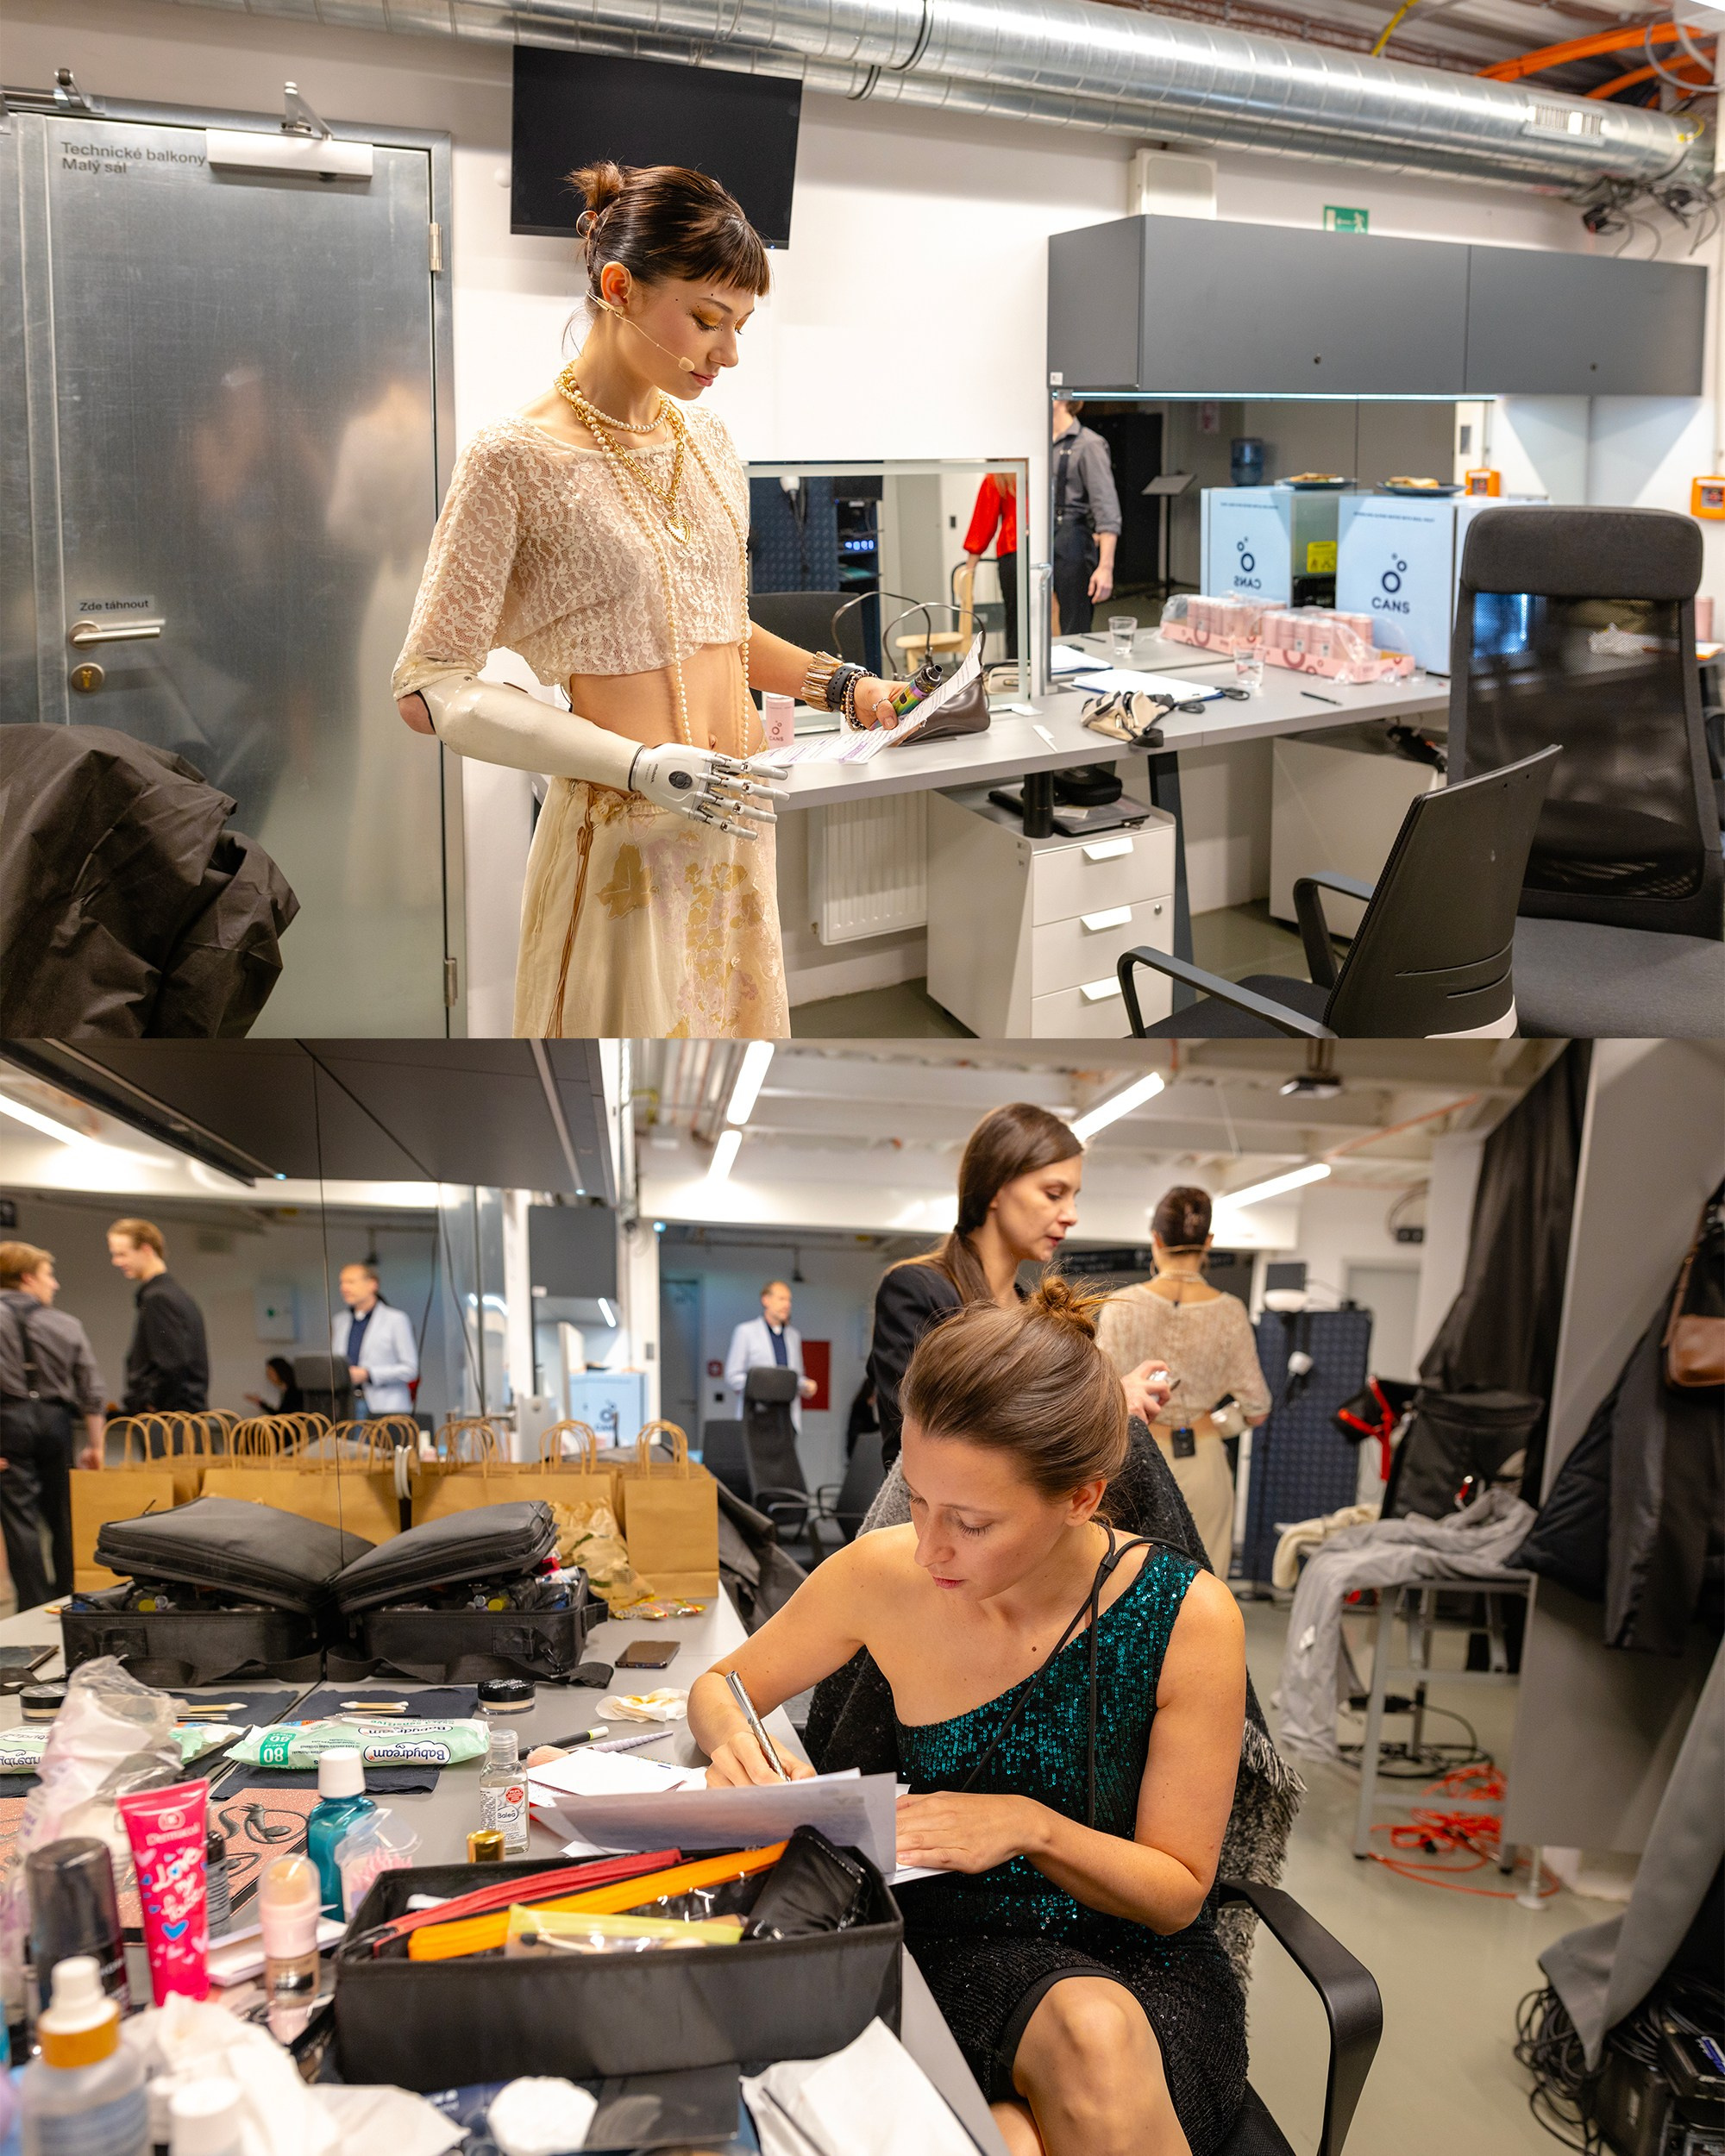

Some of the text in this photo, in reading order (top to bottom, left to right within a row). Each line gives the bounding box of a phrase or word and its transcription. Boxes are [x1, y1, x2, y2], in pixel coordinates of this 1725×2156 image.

[60, 141, 206, 166] Technické balkony
[62, 158, 127, 174] Malý sál
[79, 600, 148, 611] Zde táhnout
[1371, 597, 1410, 614] CANS
[263, 1747, 284, 1764] 80
[373, 1747, 446, 1760] Babydream
